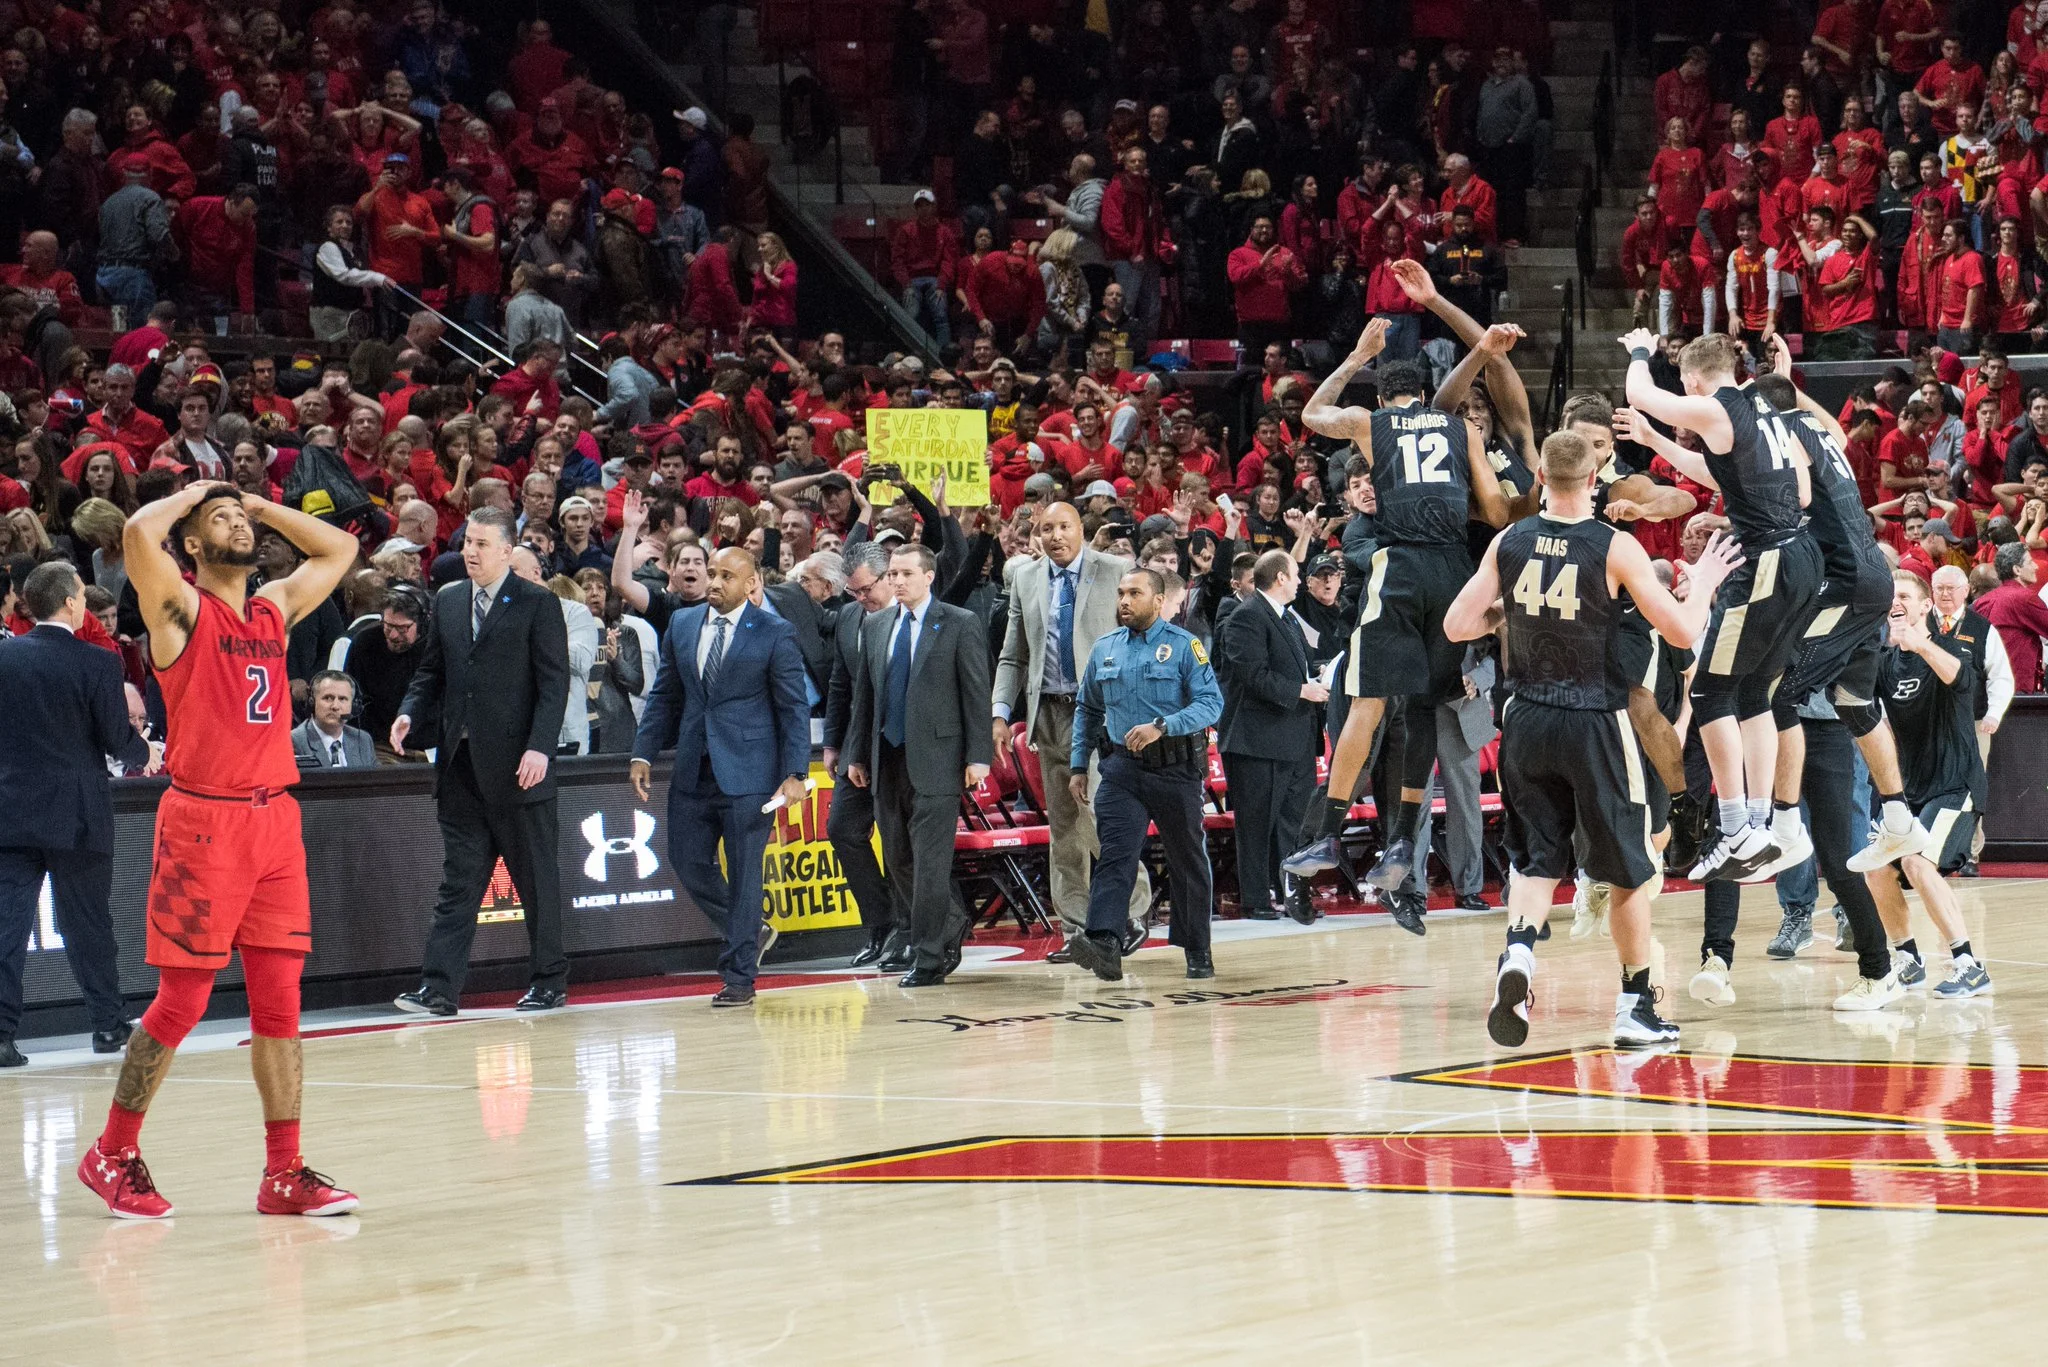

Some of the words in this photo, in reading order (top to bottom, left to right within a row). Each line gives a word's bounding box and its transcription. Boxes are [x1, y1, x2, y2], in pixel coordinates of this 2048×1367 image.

[875, 411, 961, 438] EVERY
[873, 434, 982, 460] SATURDAY
[1756, 416, 1797, 470] 14
[876, 460, 980, 483] URDUE
[1397, 433, 1451, 484] 12
[946, 484, 988, 503] OSES
[1535, 535, 1568, 557] HAAS
[1513, 559, 1581, 620] 44
[246, 664, 272, 723] 2
[573, 894, 618, 908] UNDER
[620, 889, 675, 904] ARMOUR
[762, 883, 850, 920] OUTLET
